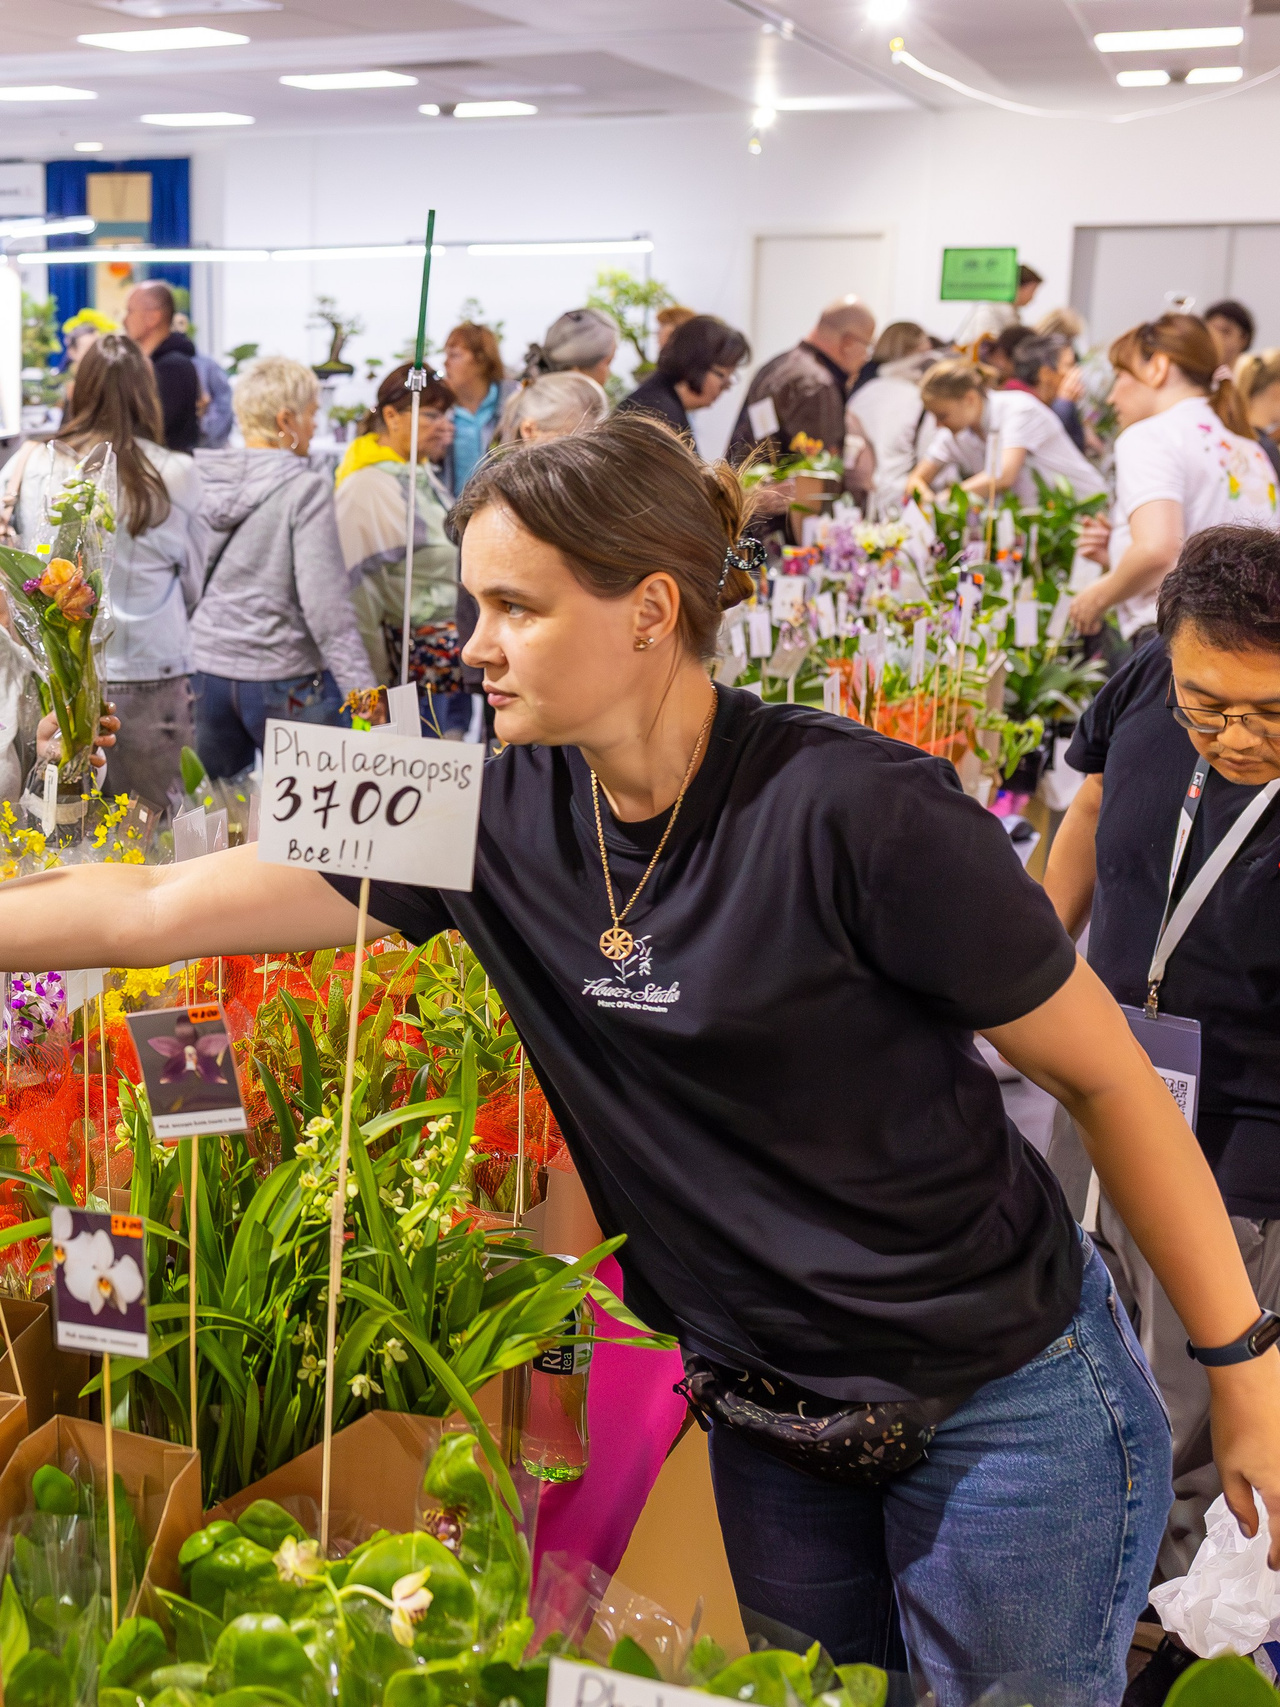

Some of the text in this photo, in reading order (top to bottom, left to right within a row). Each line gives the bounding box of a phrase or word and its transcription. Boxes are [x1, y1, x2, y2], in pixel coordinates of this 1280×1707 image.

[273, 727, 473, 792] Phalaenopsis
[272, 776, 422, 830] 3700
[582, 978, 681, 1004] Flower Studio
[562, 1352, 572, 1371] tea
